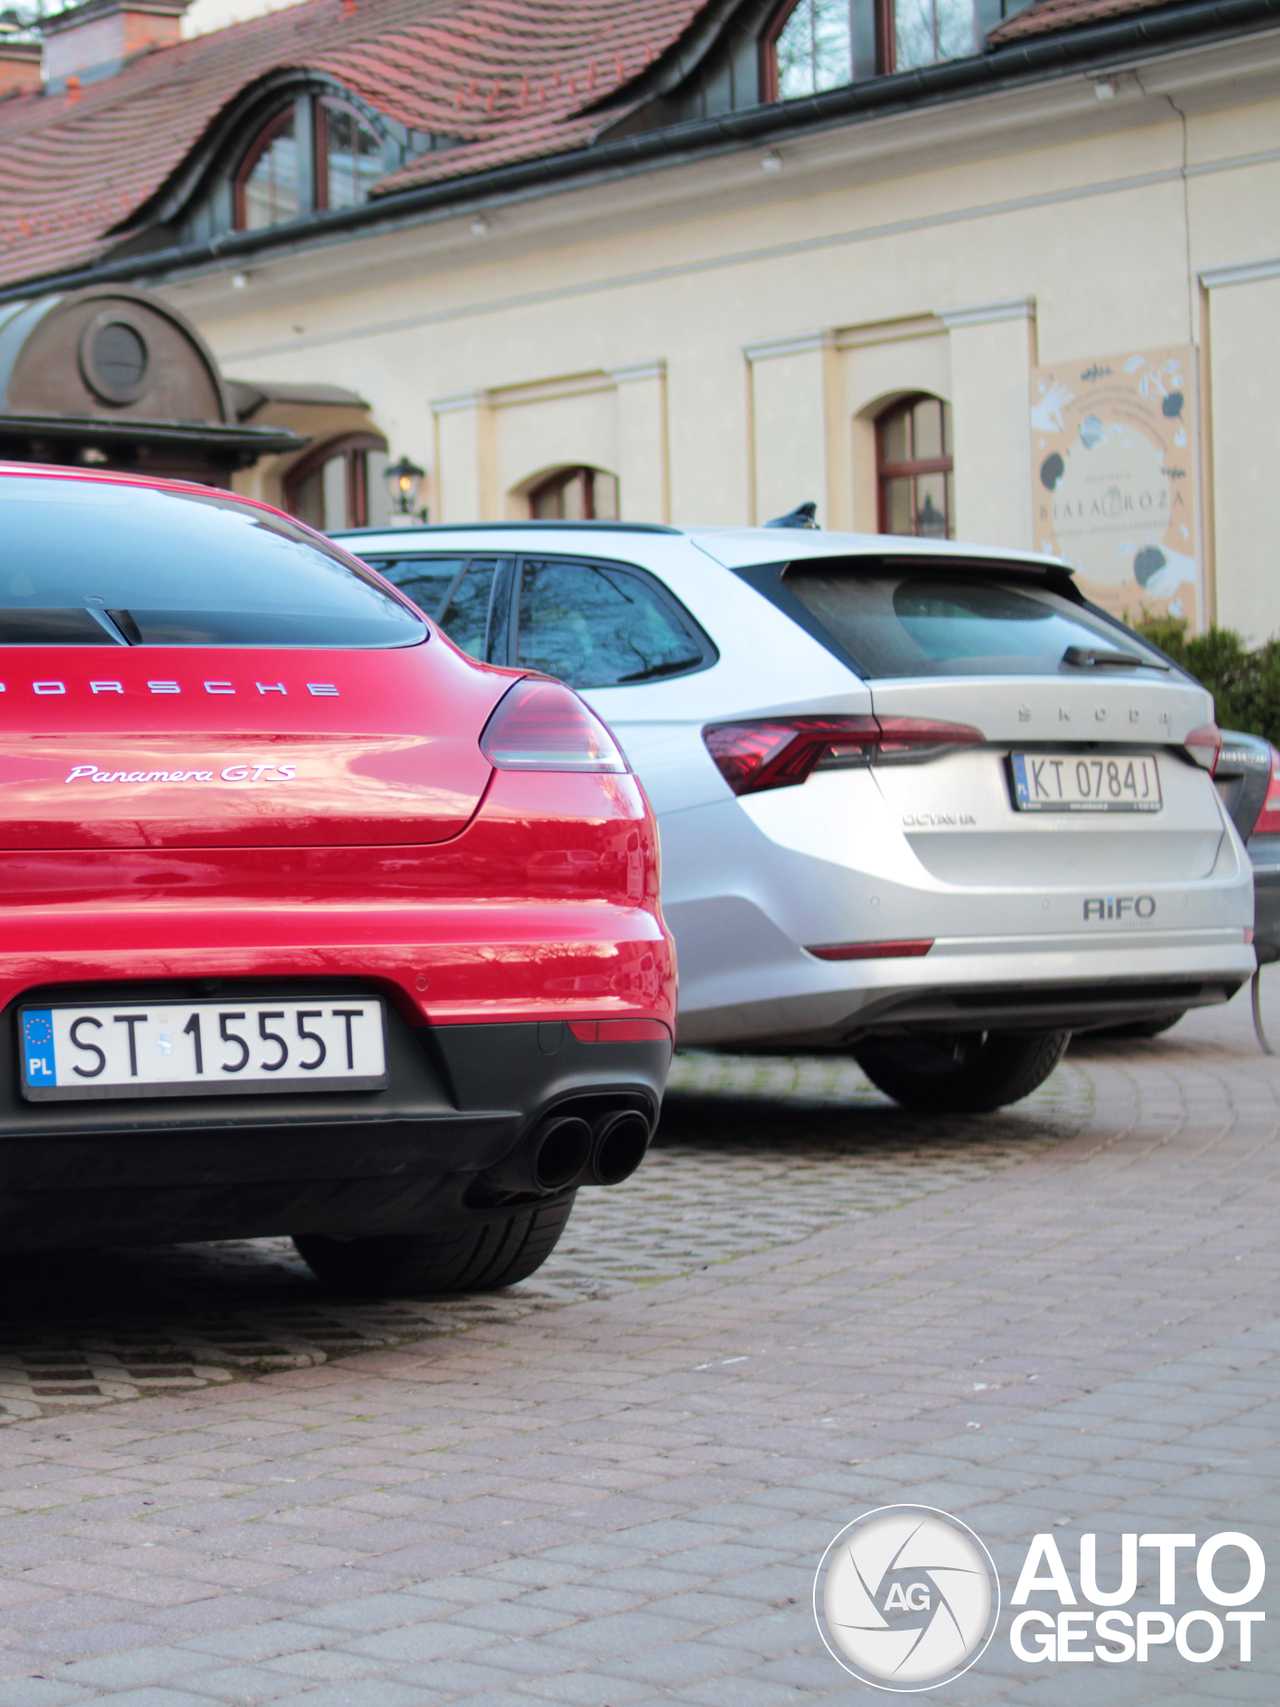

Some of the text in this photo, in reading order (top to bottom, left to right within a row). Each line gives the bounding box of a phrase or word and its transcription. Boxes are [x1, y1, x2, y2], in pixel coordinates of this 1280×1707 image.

[65, 764, 297, 784] Panamera GTS
[1031, 759, 1149, 798] KT 0784J
[1017, 783, 1028, 796] PL
[902, 812, 977, 826] OCTAVIA
[69, 1009, 364, 1078] ST 1555T
[29, 1057, 53, 1076] PL
